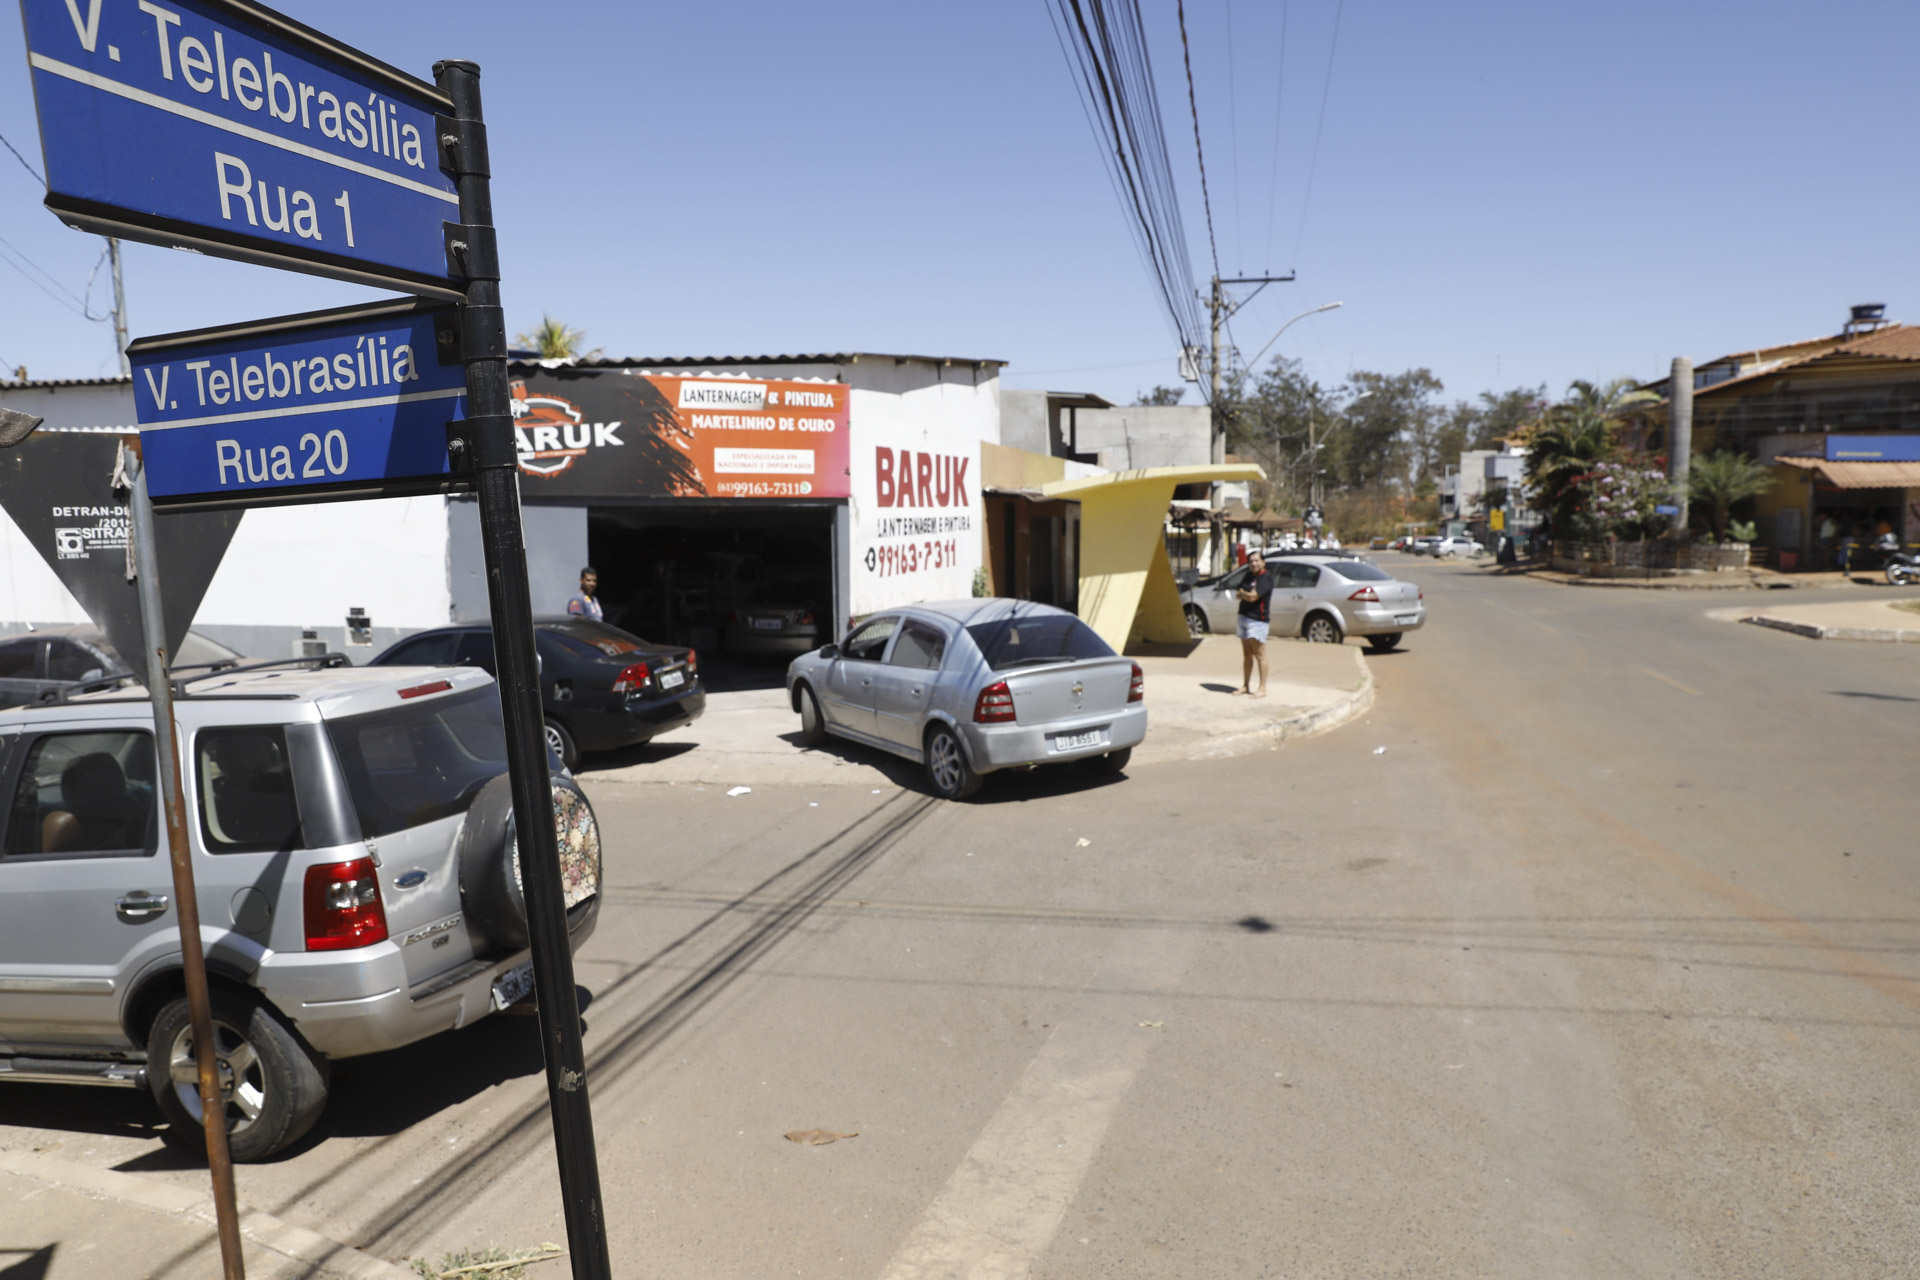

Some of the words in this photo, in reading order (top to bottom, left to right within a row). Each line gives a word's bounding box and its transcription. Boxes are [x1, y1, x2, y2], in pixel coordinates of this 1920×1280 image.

[64, 0, 121, 62] V.
[138, 0, 425, 170] Telebrasília
[214, 151, 322, 241] Rua
[334, 190, 355, 248] 1
[144, 365, 178, 411] V.
[186, 336, 419, 407] Telebrasília
[684, 389, 763, 404] LANTERNAGEM
[784, 391, 834, 408] PINTURA
[514, 421, 624, 452] ARUK
[691, 414, 775, 430] MARTELINHO
[778, 417, 794, 431] DE
[798, 418, 835, 432] OURO
[216, 439, 294, 485] Rua
[299, 429, 349, 479] 20
[875, 445, 969, 508] BARUK
[878, 538, 956, 578] 99163-7311
